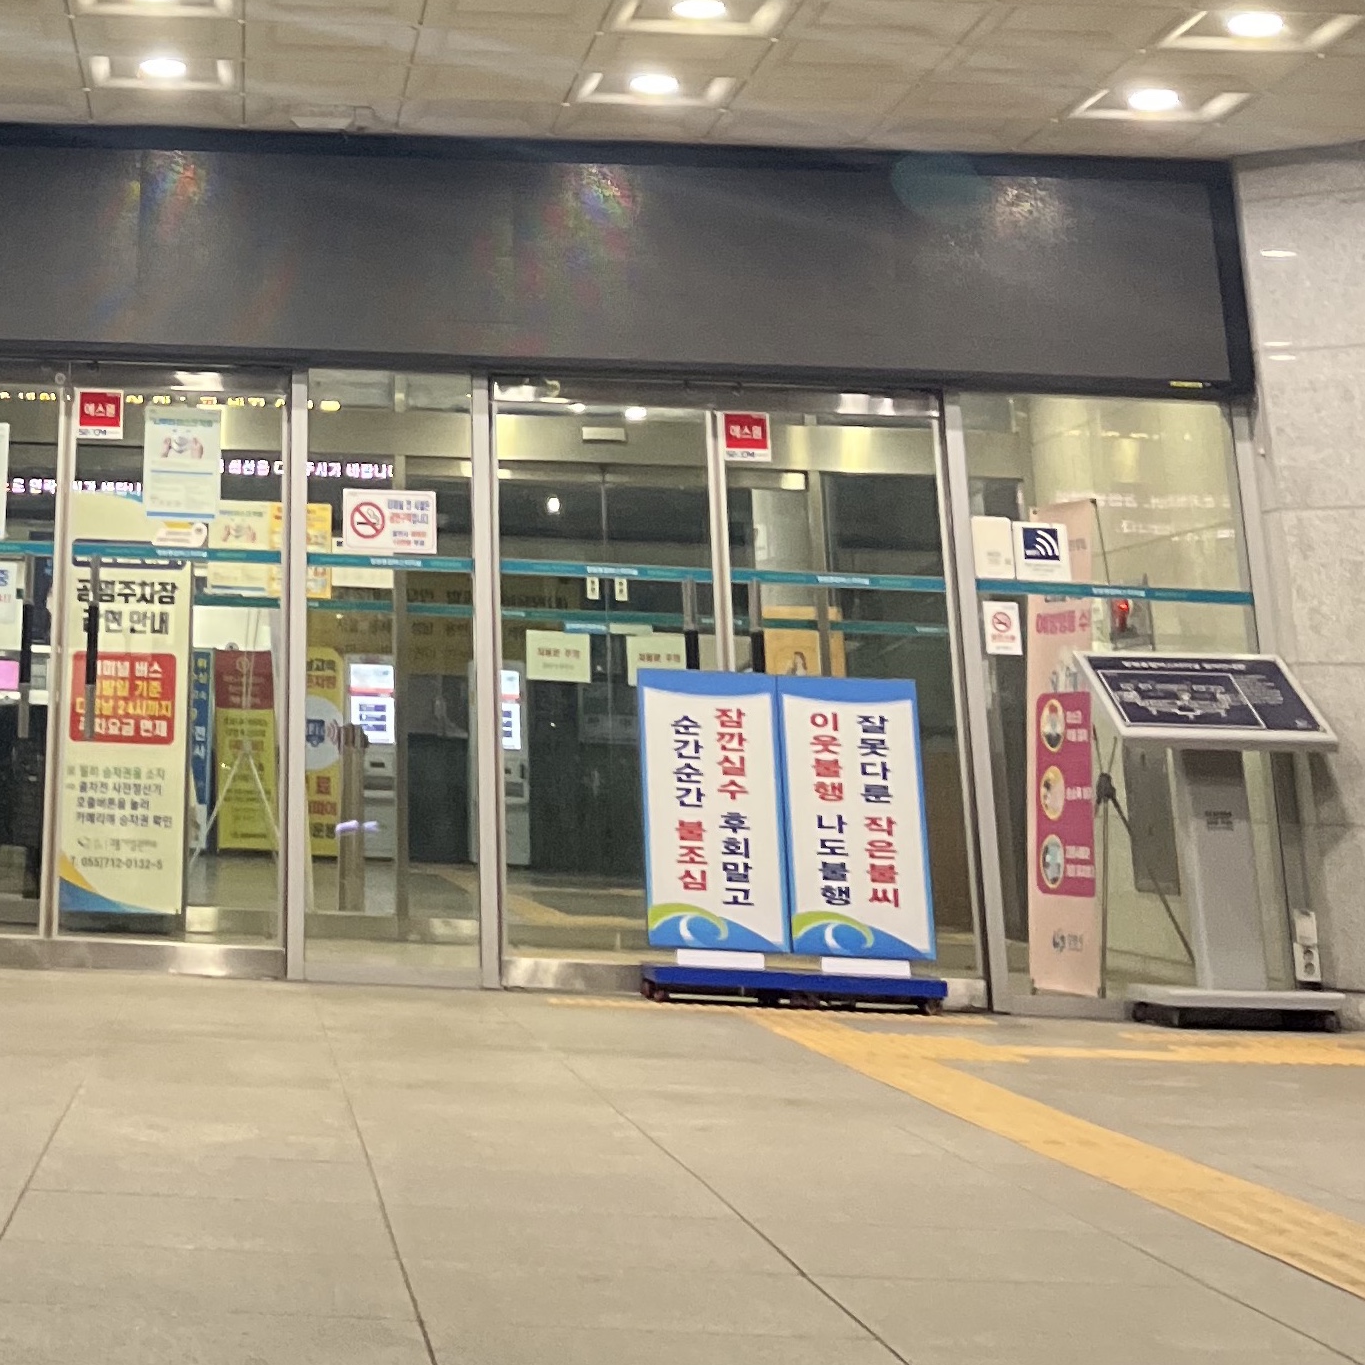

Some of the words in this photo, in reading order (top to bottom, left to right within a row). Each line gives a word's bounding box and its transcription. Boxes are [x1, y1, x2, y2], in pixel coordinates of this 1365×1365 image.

[83, 402, 116, 417] 에스원
[729, 425, 762, 439] 에스원
[129, 610, 169, 635] 안내
[134, 680, 162, 698] 기준
[135, 660, 163, 678] 버스
[117, 700, 172, 717] 24시까지
[140, 719, 168, 737] 면제
[670, 714, 705, 808] 순간순간
[715, 707, 749, 801] 잠깐실수
[809, 712, 844, 803] 이웃불행
[856, 714, 893, 804] 잘못다룬
[676, 819, 708, 892] 불조심
[719, 811, 754, 907] 후회말고
[816, 814, 852, 907] 나도불행
[863, 816, 900, 908] 작은불씨
